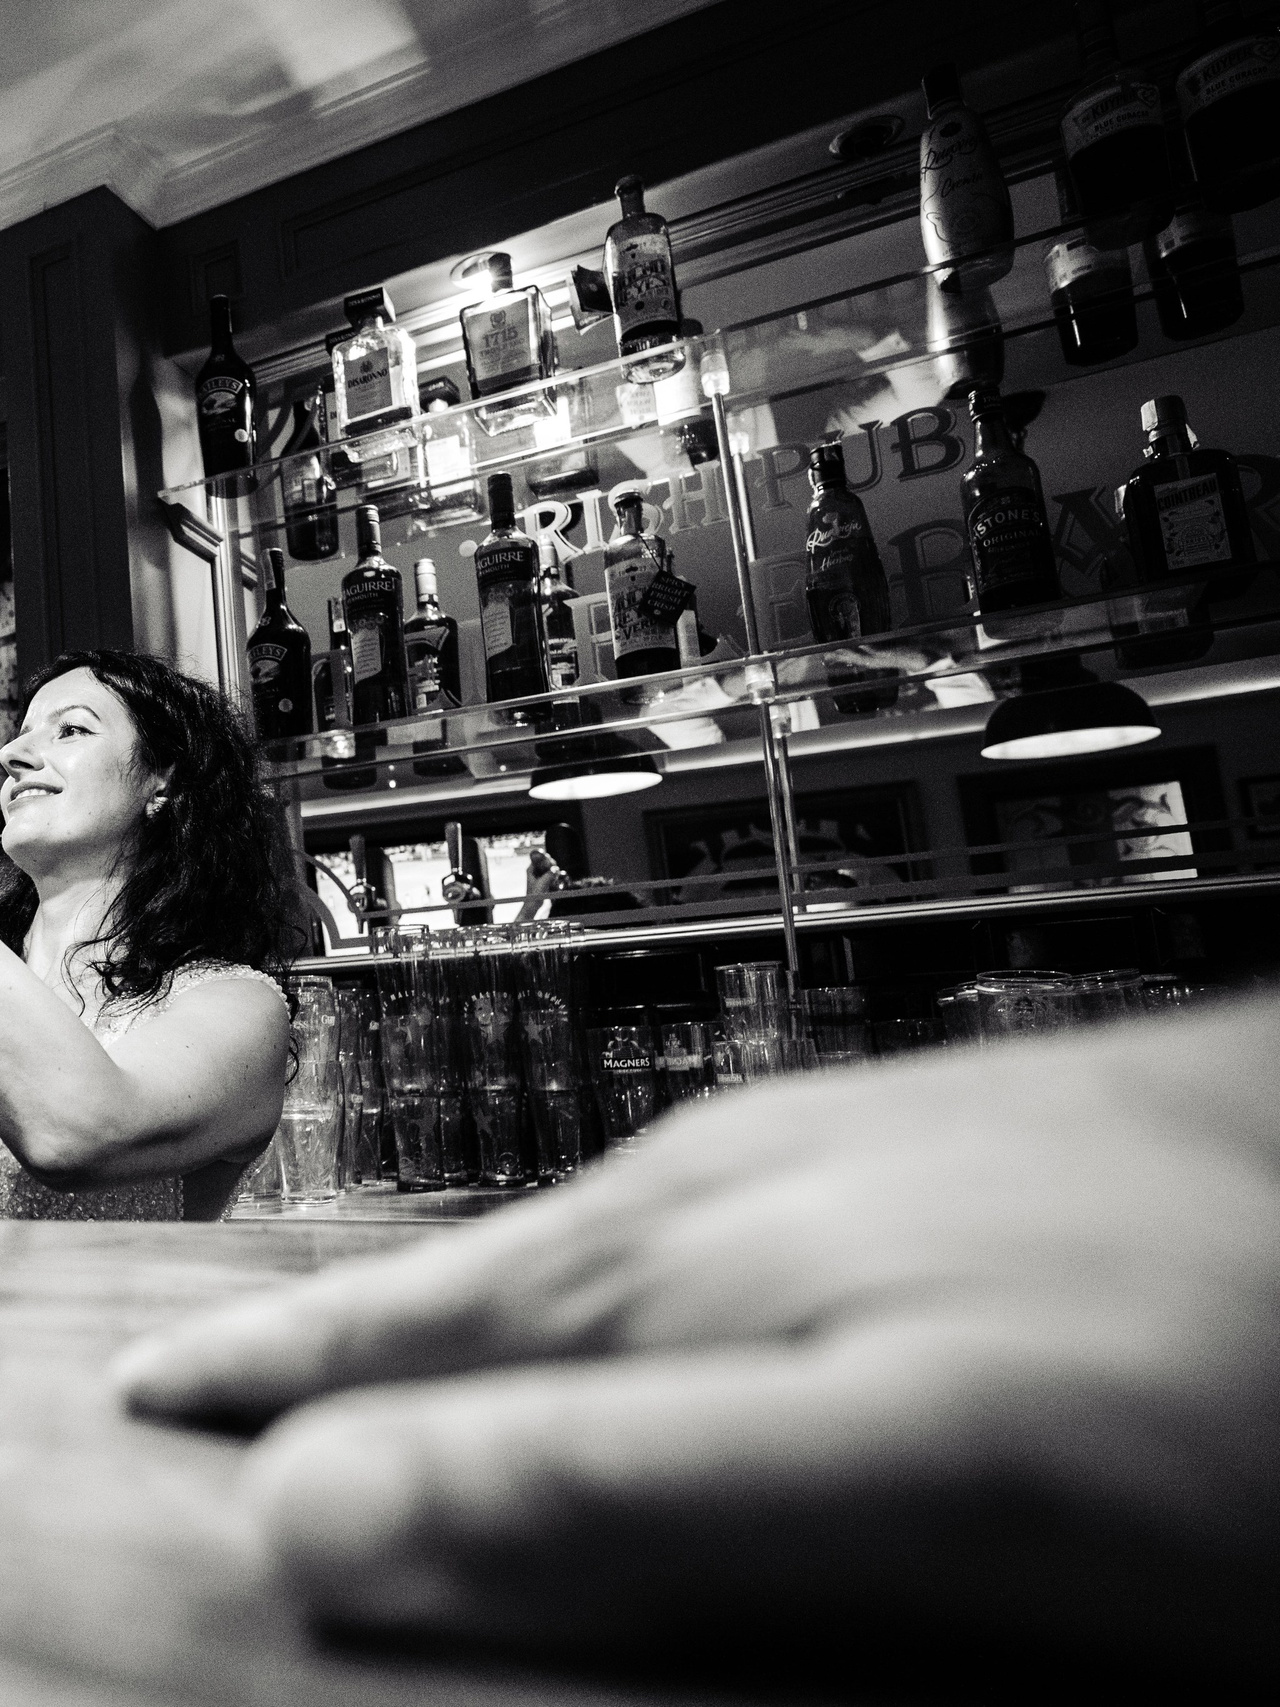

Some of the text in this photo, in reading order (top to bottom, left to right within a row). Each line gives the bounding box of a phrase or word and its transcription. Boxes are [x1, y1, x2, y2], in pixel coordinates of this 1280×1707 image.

[347, 368, 389, 389] DISARONNO
[514, 406, 967, 563] RISH PUB
[1158, 478, 1218, 511] COINTREAU
[982, 529, 1041, 548] ORIGINAL
[603, 1057, 651, 1069] MAGNERS
